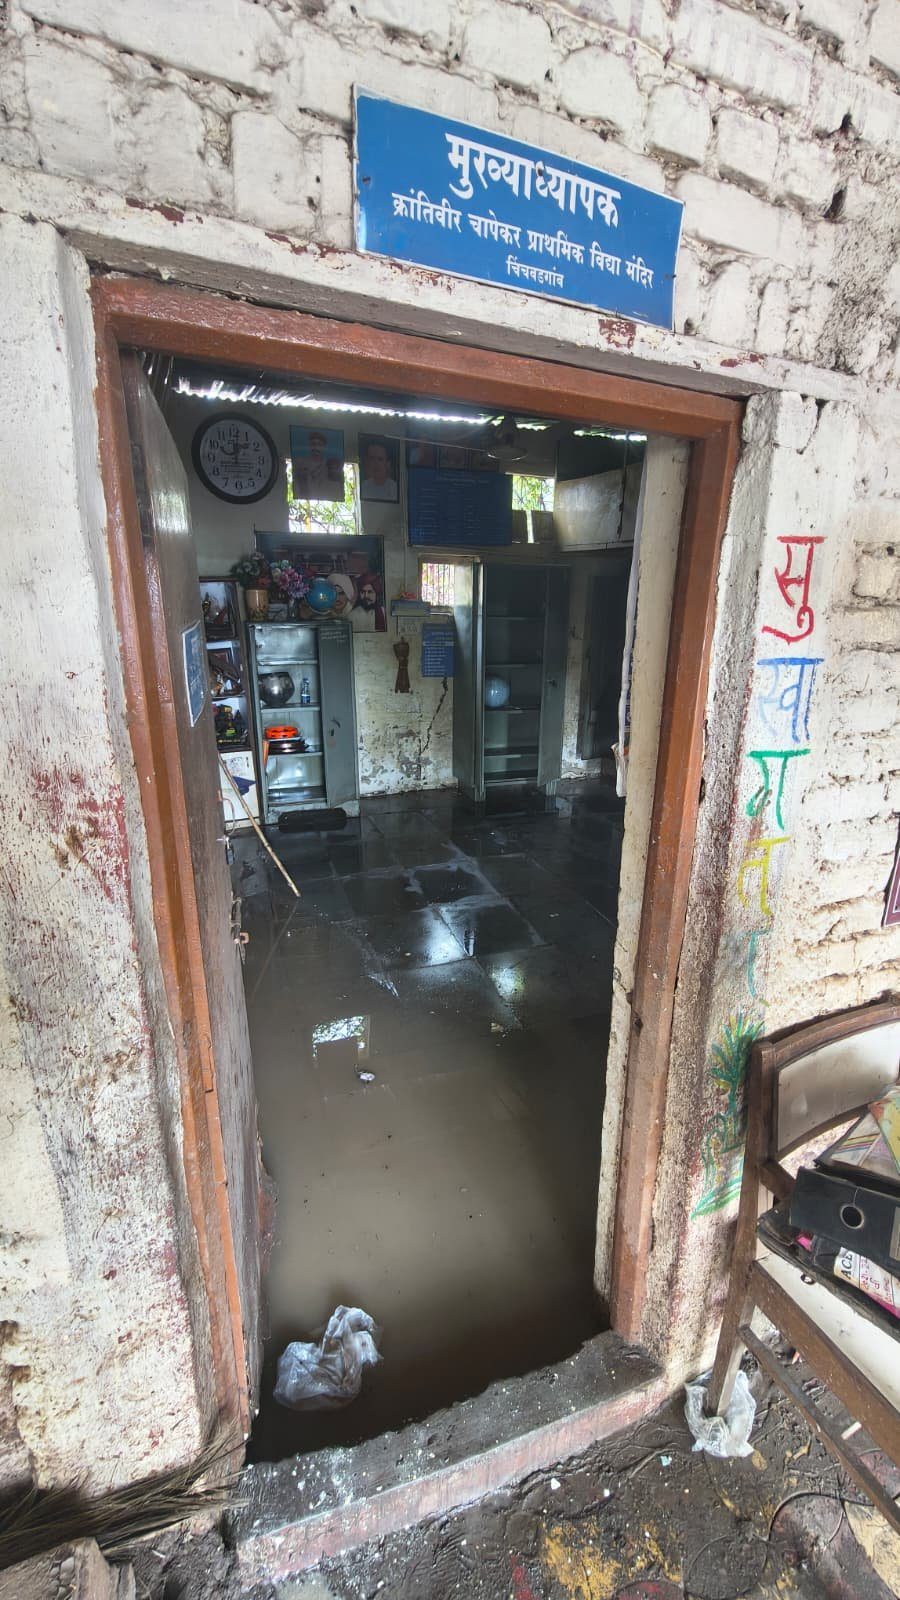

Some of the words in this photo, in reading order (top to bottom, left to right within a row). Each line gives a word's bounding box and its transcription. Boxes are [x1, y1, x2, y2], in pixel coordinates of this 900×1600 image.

[445, 132, 622, 229] मुख्याध्यापक
[392, 188, 462, 233] क्रांतिवीर
[467, 209, 522, 249] चापेकर
[526, 230, 585, 265] प्राथमिक
[589, 240, 622, 276] विद्या
[625, 254, 654, 290] मंदिर
